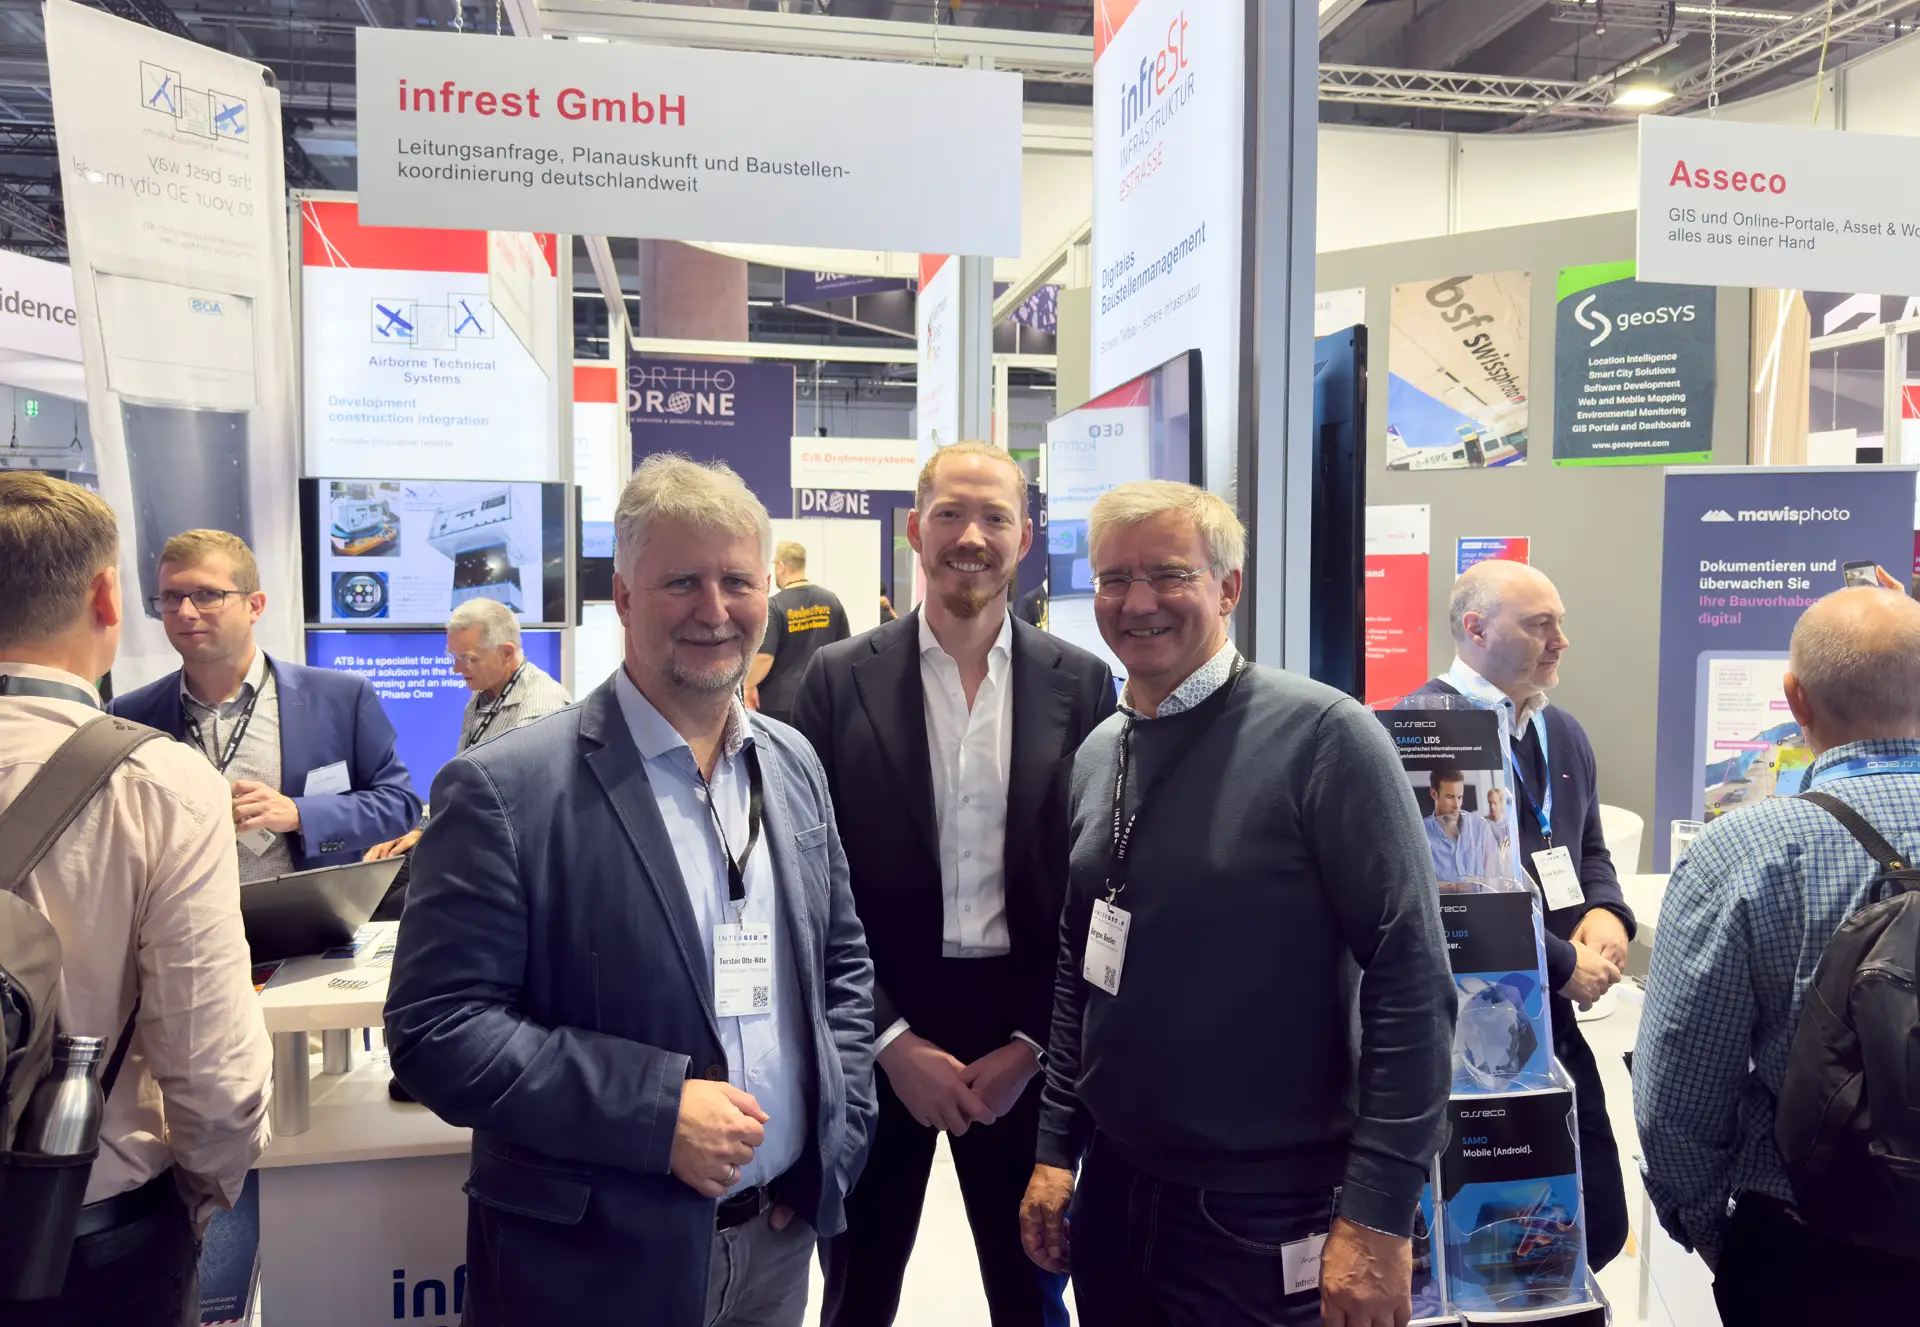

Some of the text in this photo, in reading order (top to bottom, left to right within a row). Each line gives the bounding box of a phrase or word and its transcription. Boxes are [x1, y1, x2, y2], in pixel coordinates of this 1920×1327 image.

[399, 79, 685, 126] infrest GmbH
[1119, 72, 1194, 170] INFRASTRUKTUR
[397, 138, 851, 178] Leitungsanfrage, Planauskunft und Baustellen-
[397, 162, 698, 193] koordinierung deutschlandweit
[1669, 160, 1787, 194] Asseco
[1668, 207, 1696, 223] GIS
[1701, 211, 1728, 225] und
[1733, 212, 1839, 234] Online-Portale,
[1843, 220, 1882, 235] Asset
[1887, 223, 1897, 236] &
[1668, 228, 1815, 250] alles aus einer Hand
[1101, 220, 1206, 316] Baustellenmanagement
[1102, 251, 1135, 289] Digitales
[1425, 275, 1494, 332] bsf
[1616, 305, 1696, 331] geoSYS
[369, 356, 496, 371] Airborne Technical
[1588, 353, 1677, 366] Location Intelligence
[1462, 333, 1521, 402] swissphoto
[1588, 366, 1676, 379] Smart City Solutions
[404, 372, 461, 384] Systems
[1584, 380, 1681, 393] Software Development
[328, 395, 417, 410] Development
[626, 389, 735, 416] DRONE
[1578, 393, 1686, 406] Web and Mobile Mapping
[328, 411, 489, 427] construction integration
[1577, 406, 1687, 419] Environmental Monitoring
[1572, 419, 1691, 433] GIS Portals and Dashboards
[1592, 440, 1669, 450] www.geosysnet.com
[824, 454, 916, 465] Drohnensysteme
[801, 489, 870, 516] DRONE
[1738, 506, 1850, 525] mawisphoto
[1700, 560, 1837, 573] Dokumentieren und
[1700, 576, 1811, 589] überwachen Sie
[1699, 595, 1726, 607] Ihre
[1698, 612, 1742, 627] digital
[334, 656, 354, 666] ATS
[356, 656, 365, 666] is
[367, 658, 374, 666] a
[375, 656, 419, 667] specialist
[420, 656, 433, 665] for
[377, 667, 420, 677] solutions
[421, 667, 430, 676] in
[432, 667, 448, 676] the
[407, 679, 426, 688] and
[427, 680, 440, 688] an
[381, 689, 434, 699] Phase One
[1395, 736, 1441, 744] SAMO LIDS
[1452, 930, 1469, 938] LIDS
[1460, 1109, 1506, 1118] asseco
[1462, 1136, 1488, 1145] SAMO
[1463, 1149, 1492, 1158] Mobile
